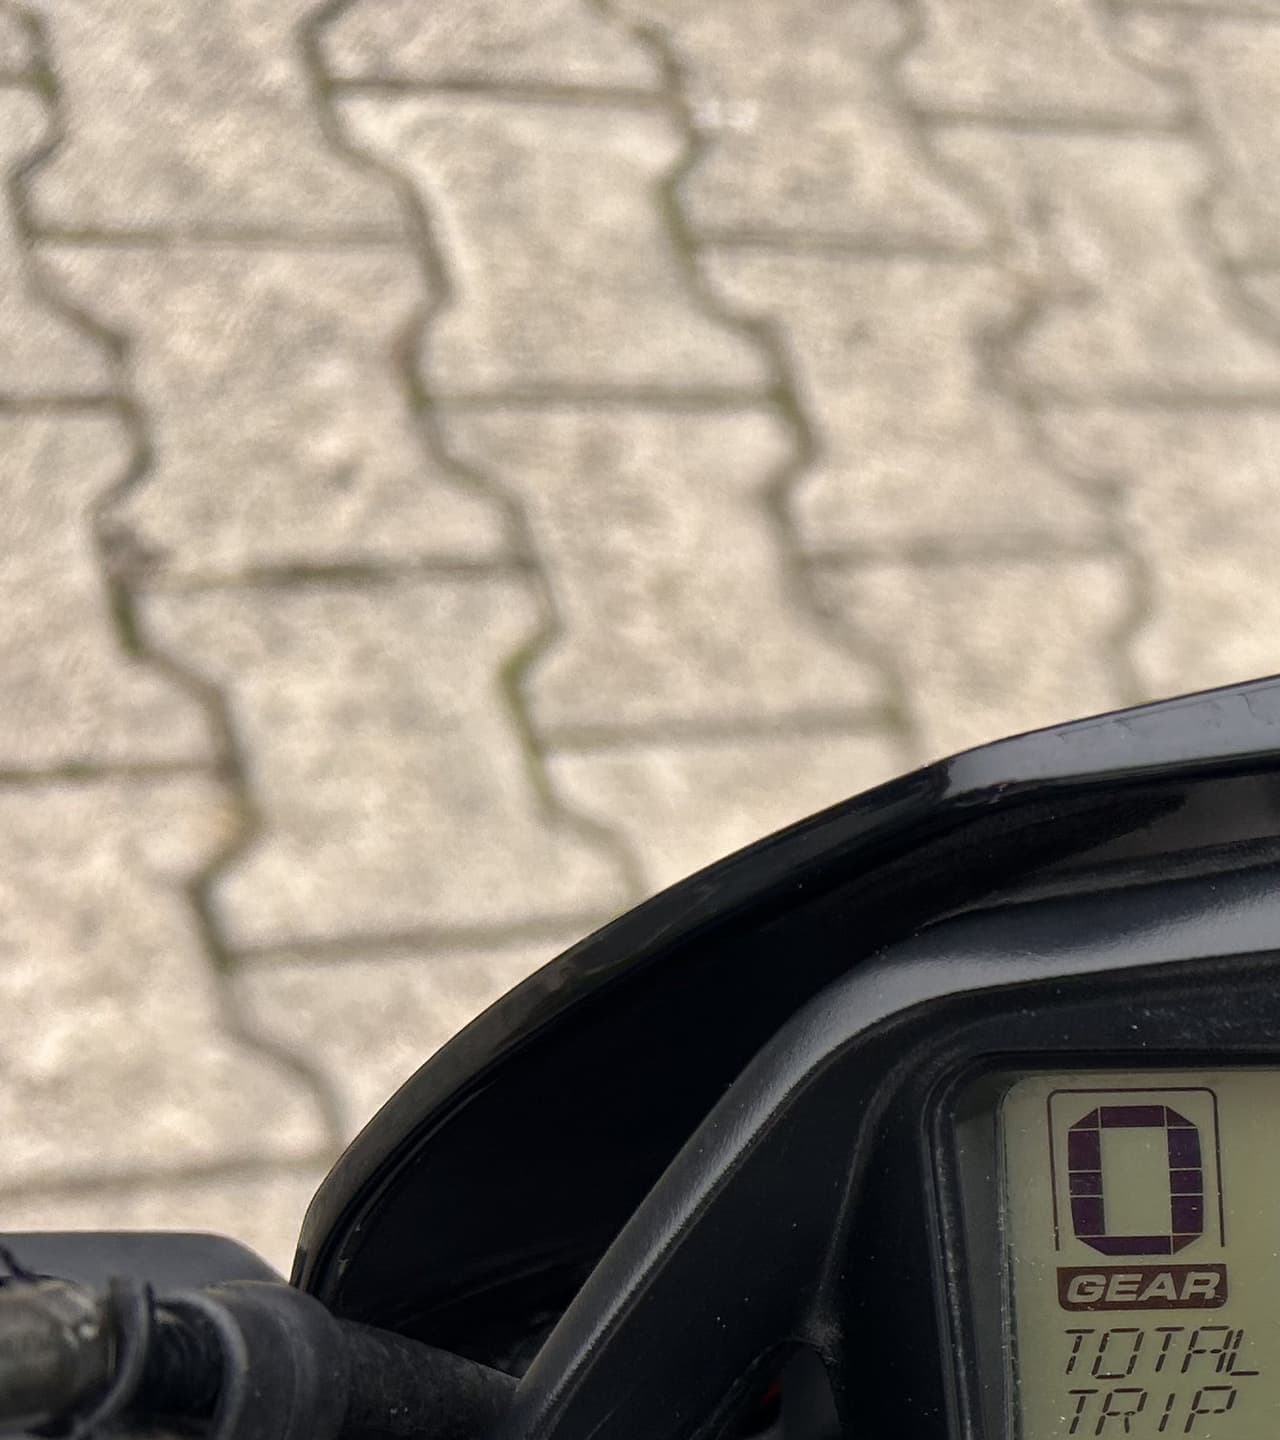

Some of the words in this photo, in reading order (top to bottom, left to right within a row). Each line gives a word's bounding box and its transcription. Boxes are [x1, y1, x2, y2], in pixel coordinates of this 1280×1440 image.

[1068, 1105, 1203, 1256] 0
[1066, 1271, 1222, 1304] GEAR
[1064, 1325, 1260, 1379] TOTAL
[1066, 1385, 1238, 1436] TRIP
